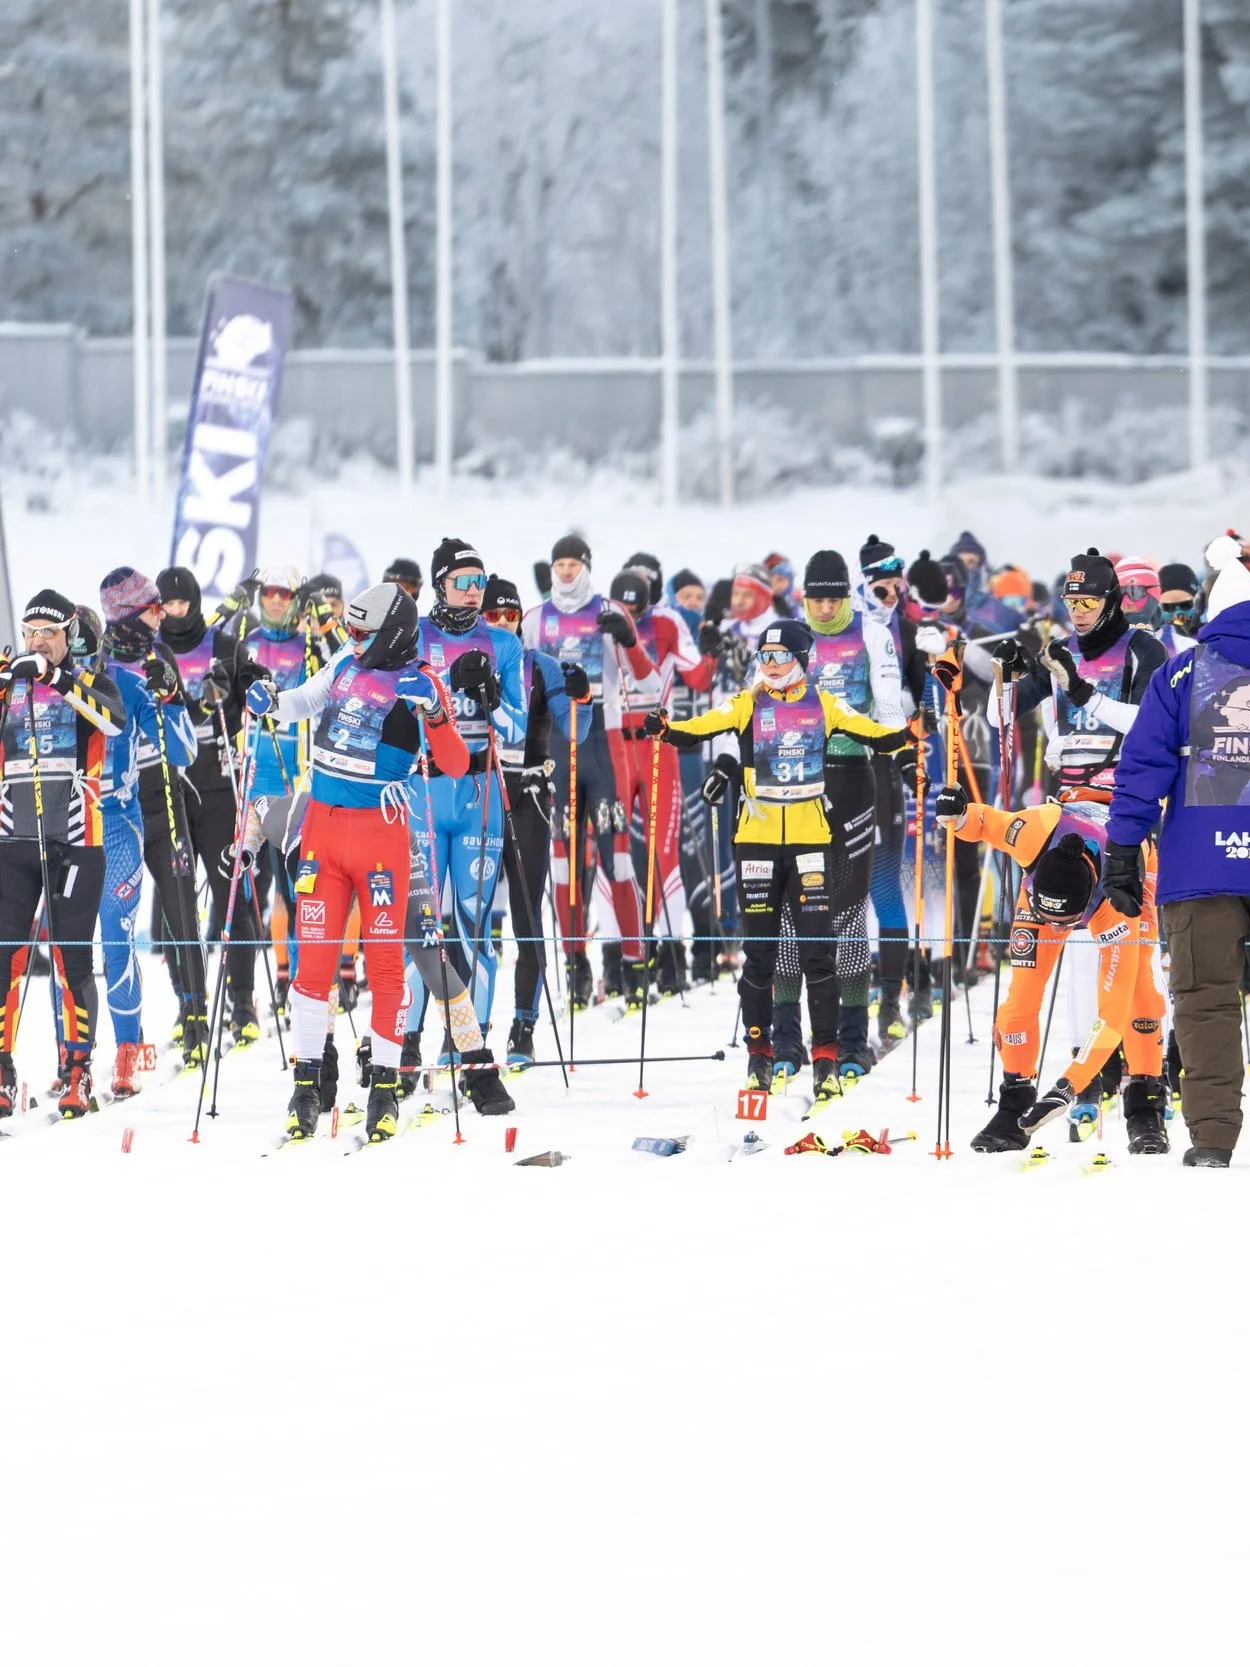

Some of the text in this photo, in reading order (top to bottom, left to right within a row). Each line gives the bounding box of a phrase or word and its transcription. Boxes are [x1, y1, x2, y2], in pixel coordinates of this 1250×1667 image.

[819, 679, 845, 690] FINSKI
[338, 712, 361, 726] FINSKI
[25, 735, 54, 755] 15
[334, 728, 350, 750] 2
[777, 748, 805, 757] FINSKI
[777, 761, 804, 782] 31
[745, 863, 769, 874] Atria
[1100, 922, 1129, 943] Rauta
[1104, 945, 1120, 992] SILVINI
[136, 1048, 156, 1070] 43
[739, 1093, 765, 1117] 17
